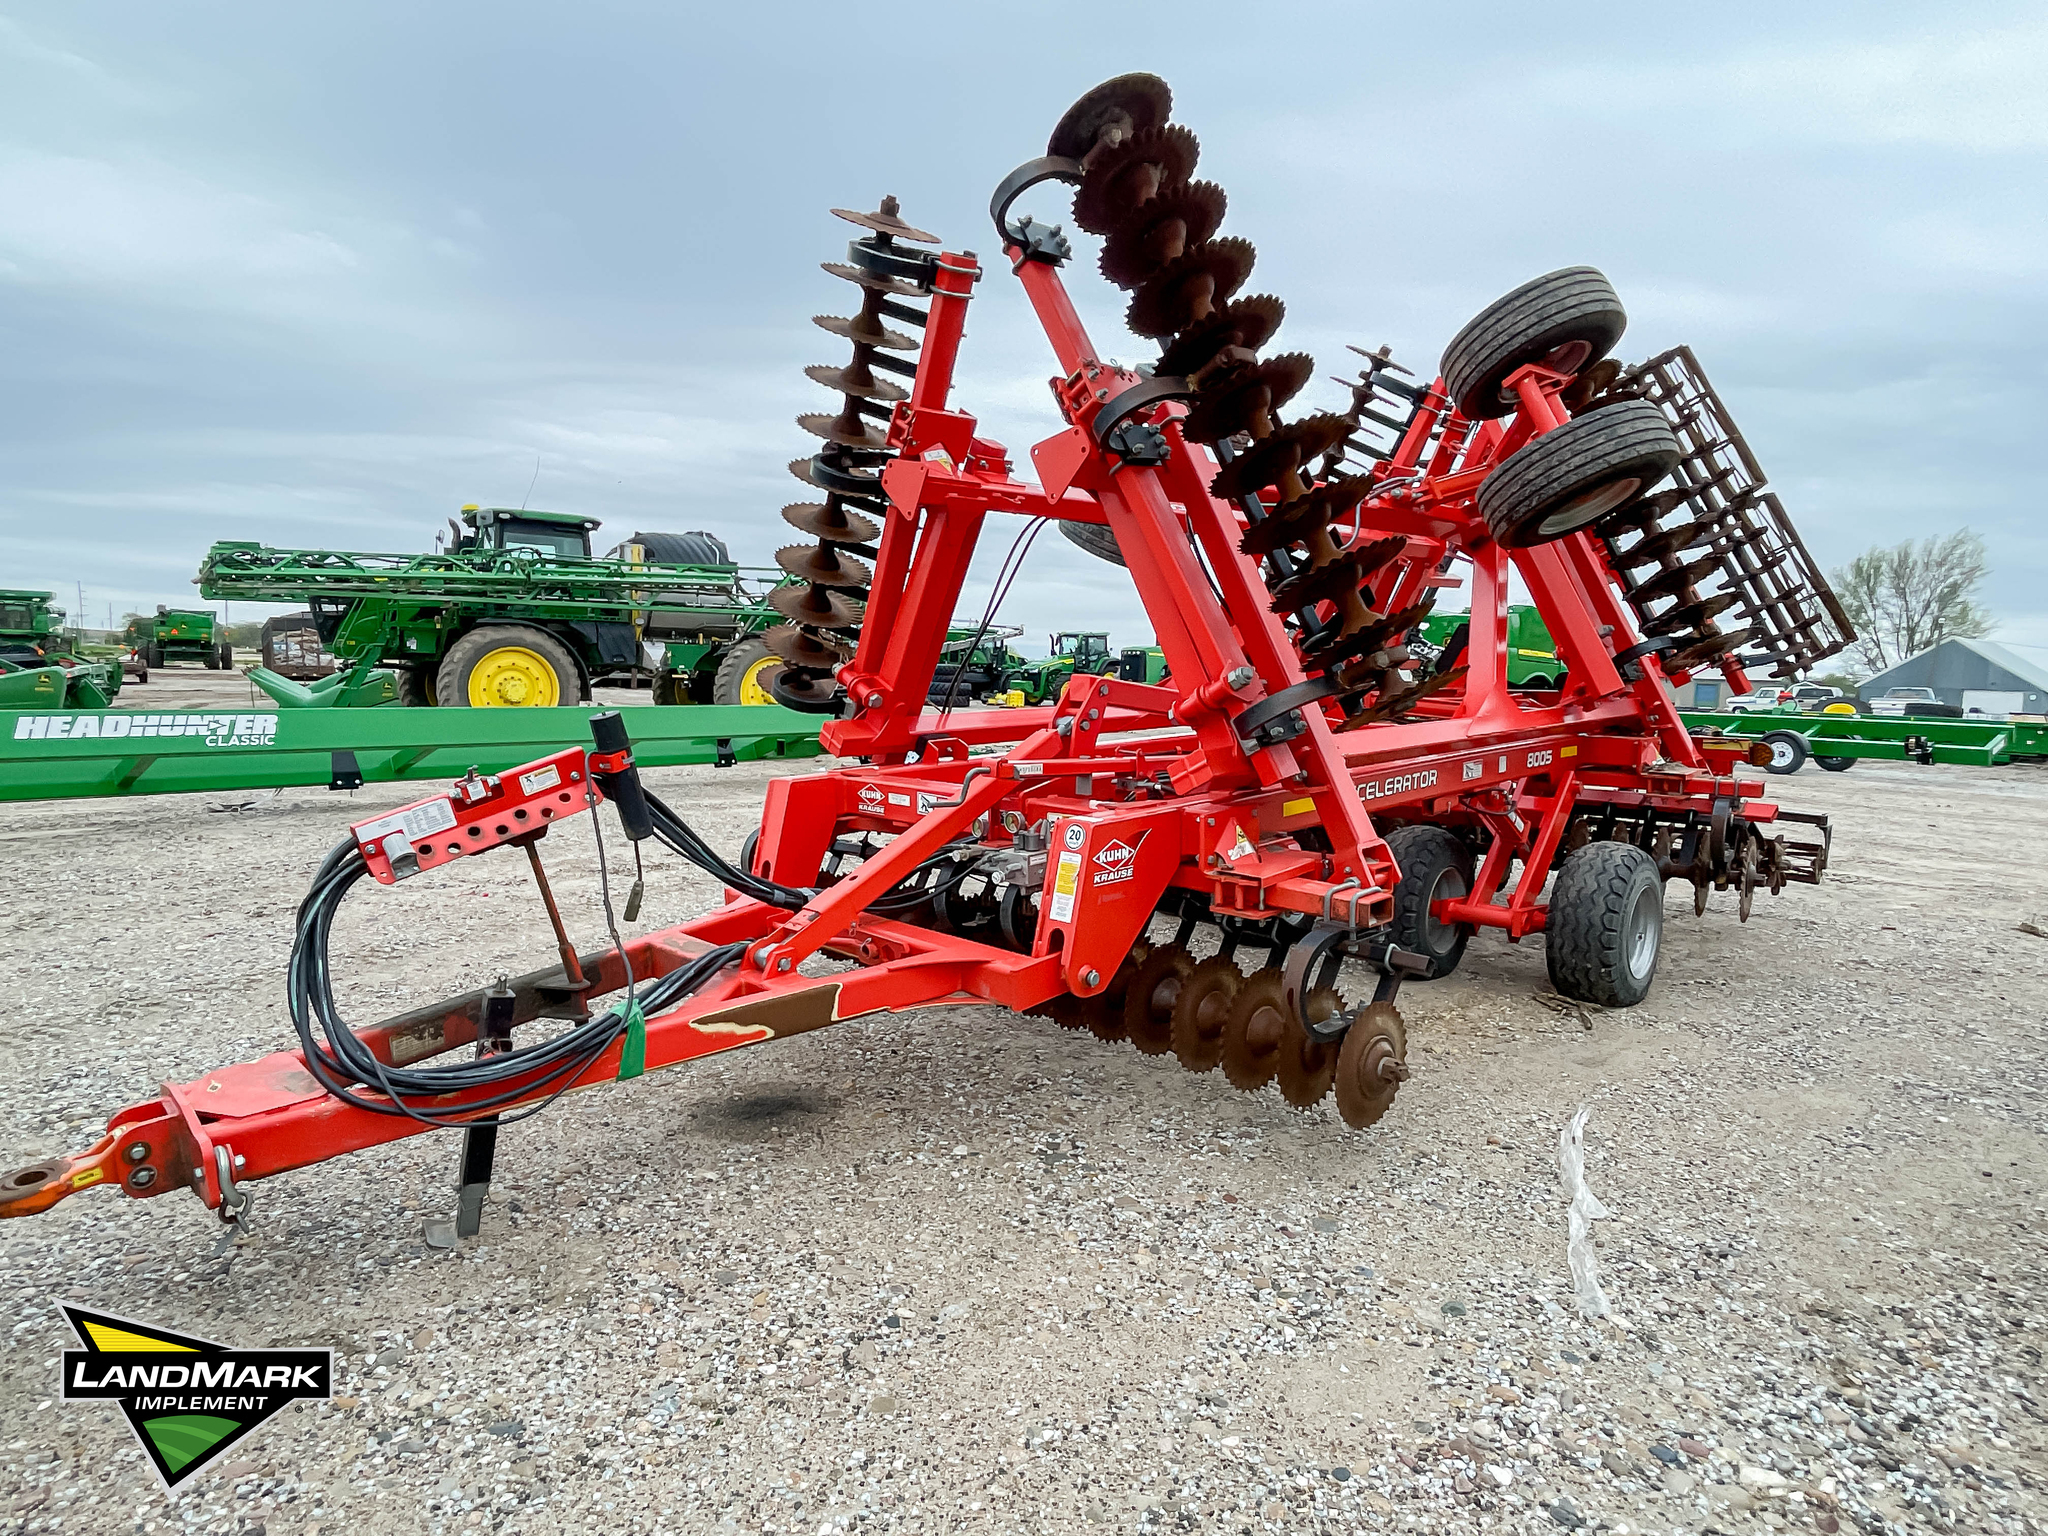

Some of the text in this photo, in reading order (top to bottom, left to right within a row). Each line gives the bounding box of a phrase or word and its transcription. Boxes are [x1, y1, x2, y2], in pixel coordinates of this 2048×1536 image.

[13, 714, 279, 739] HEADHUNTER
[205, 734, 276, 747] CLASSIC
[1527, 750, 1553, 768] 8005
[1355, 769, 1438, 801] CELERATOR
[861, 789, 881, 801] KUHN
[1069, 829, 1081, 841] 20
[1100, 847, 1129, 863] KUHN
[1093, 867, 1134, 884] KRAUSE
